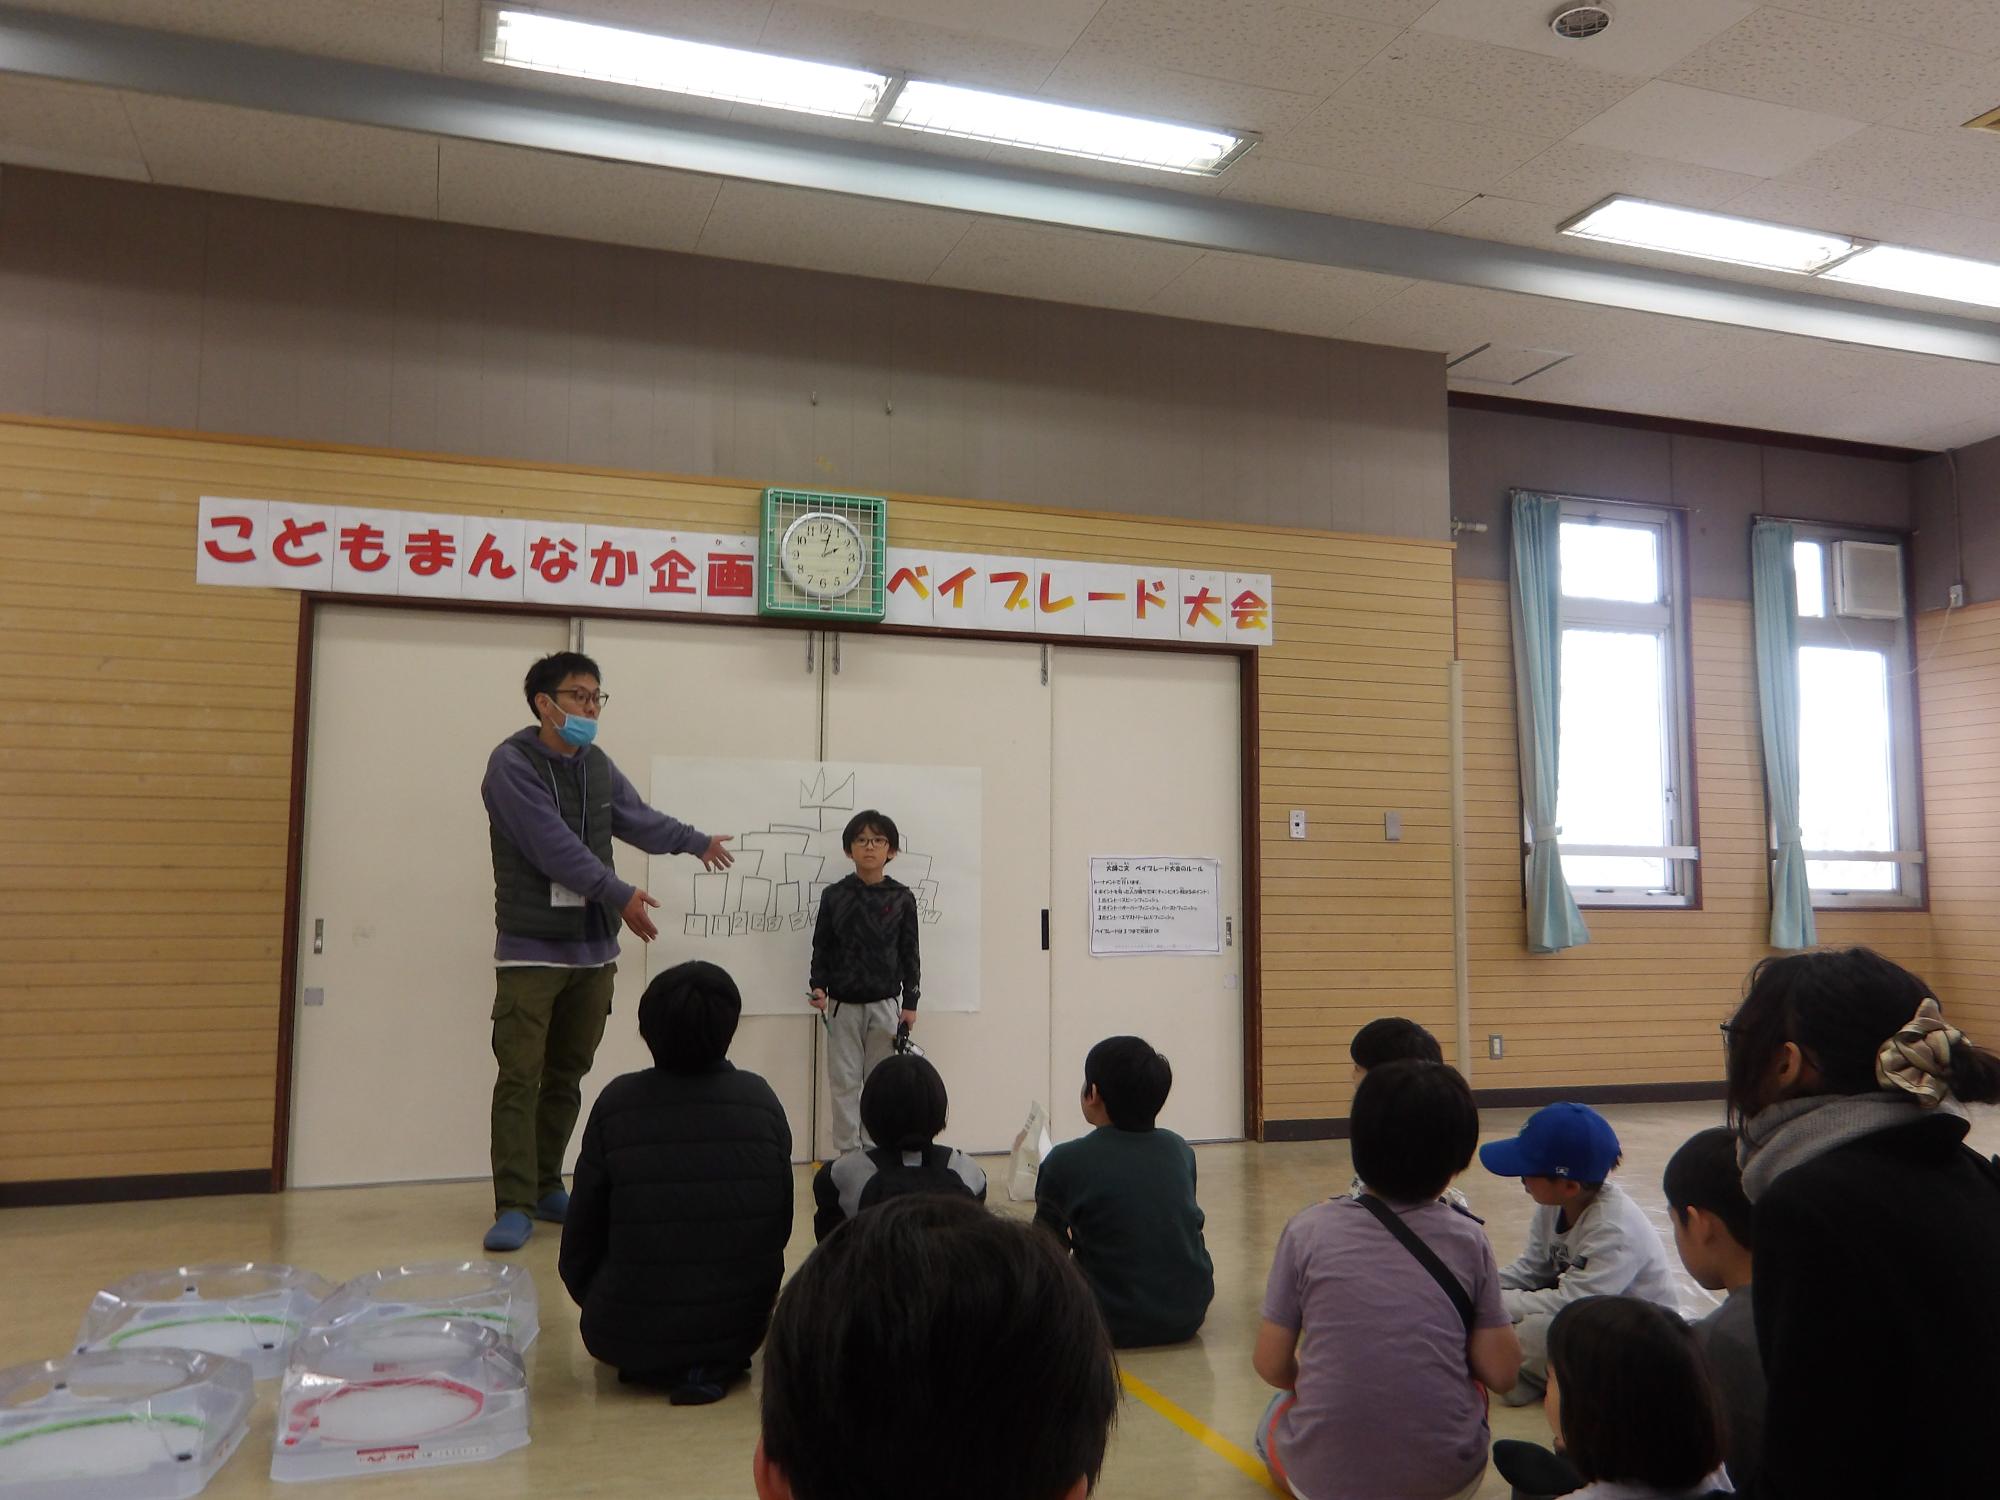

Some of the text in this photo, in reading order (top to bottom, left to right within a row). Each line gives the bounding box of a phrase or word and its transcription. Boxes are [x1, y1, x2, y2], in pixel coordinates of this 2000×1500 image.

[807, 525, 815, 537] 11
[820, 523, 829, 533] 12
[797, 535, 807, 545] 10
[844, 539, 851, 547] 2
[204, 516, 755, 598] こどもまんなか企画
[792, 550, 800, 560] 9
[848, 553, 856, 562] 3
[797, 564, 804, 574] 8
[807, 574, 814, 584] 7
[819, 578, 827, 588] 6
[834, 576, 841, 586] 5
[886, 565, 1268, 630] ベイブレード大会
